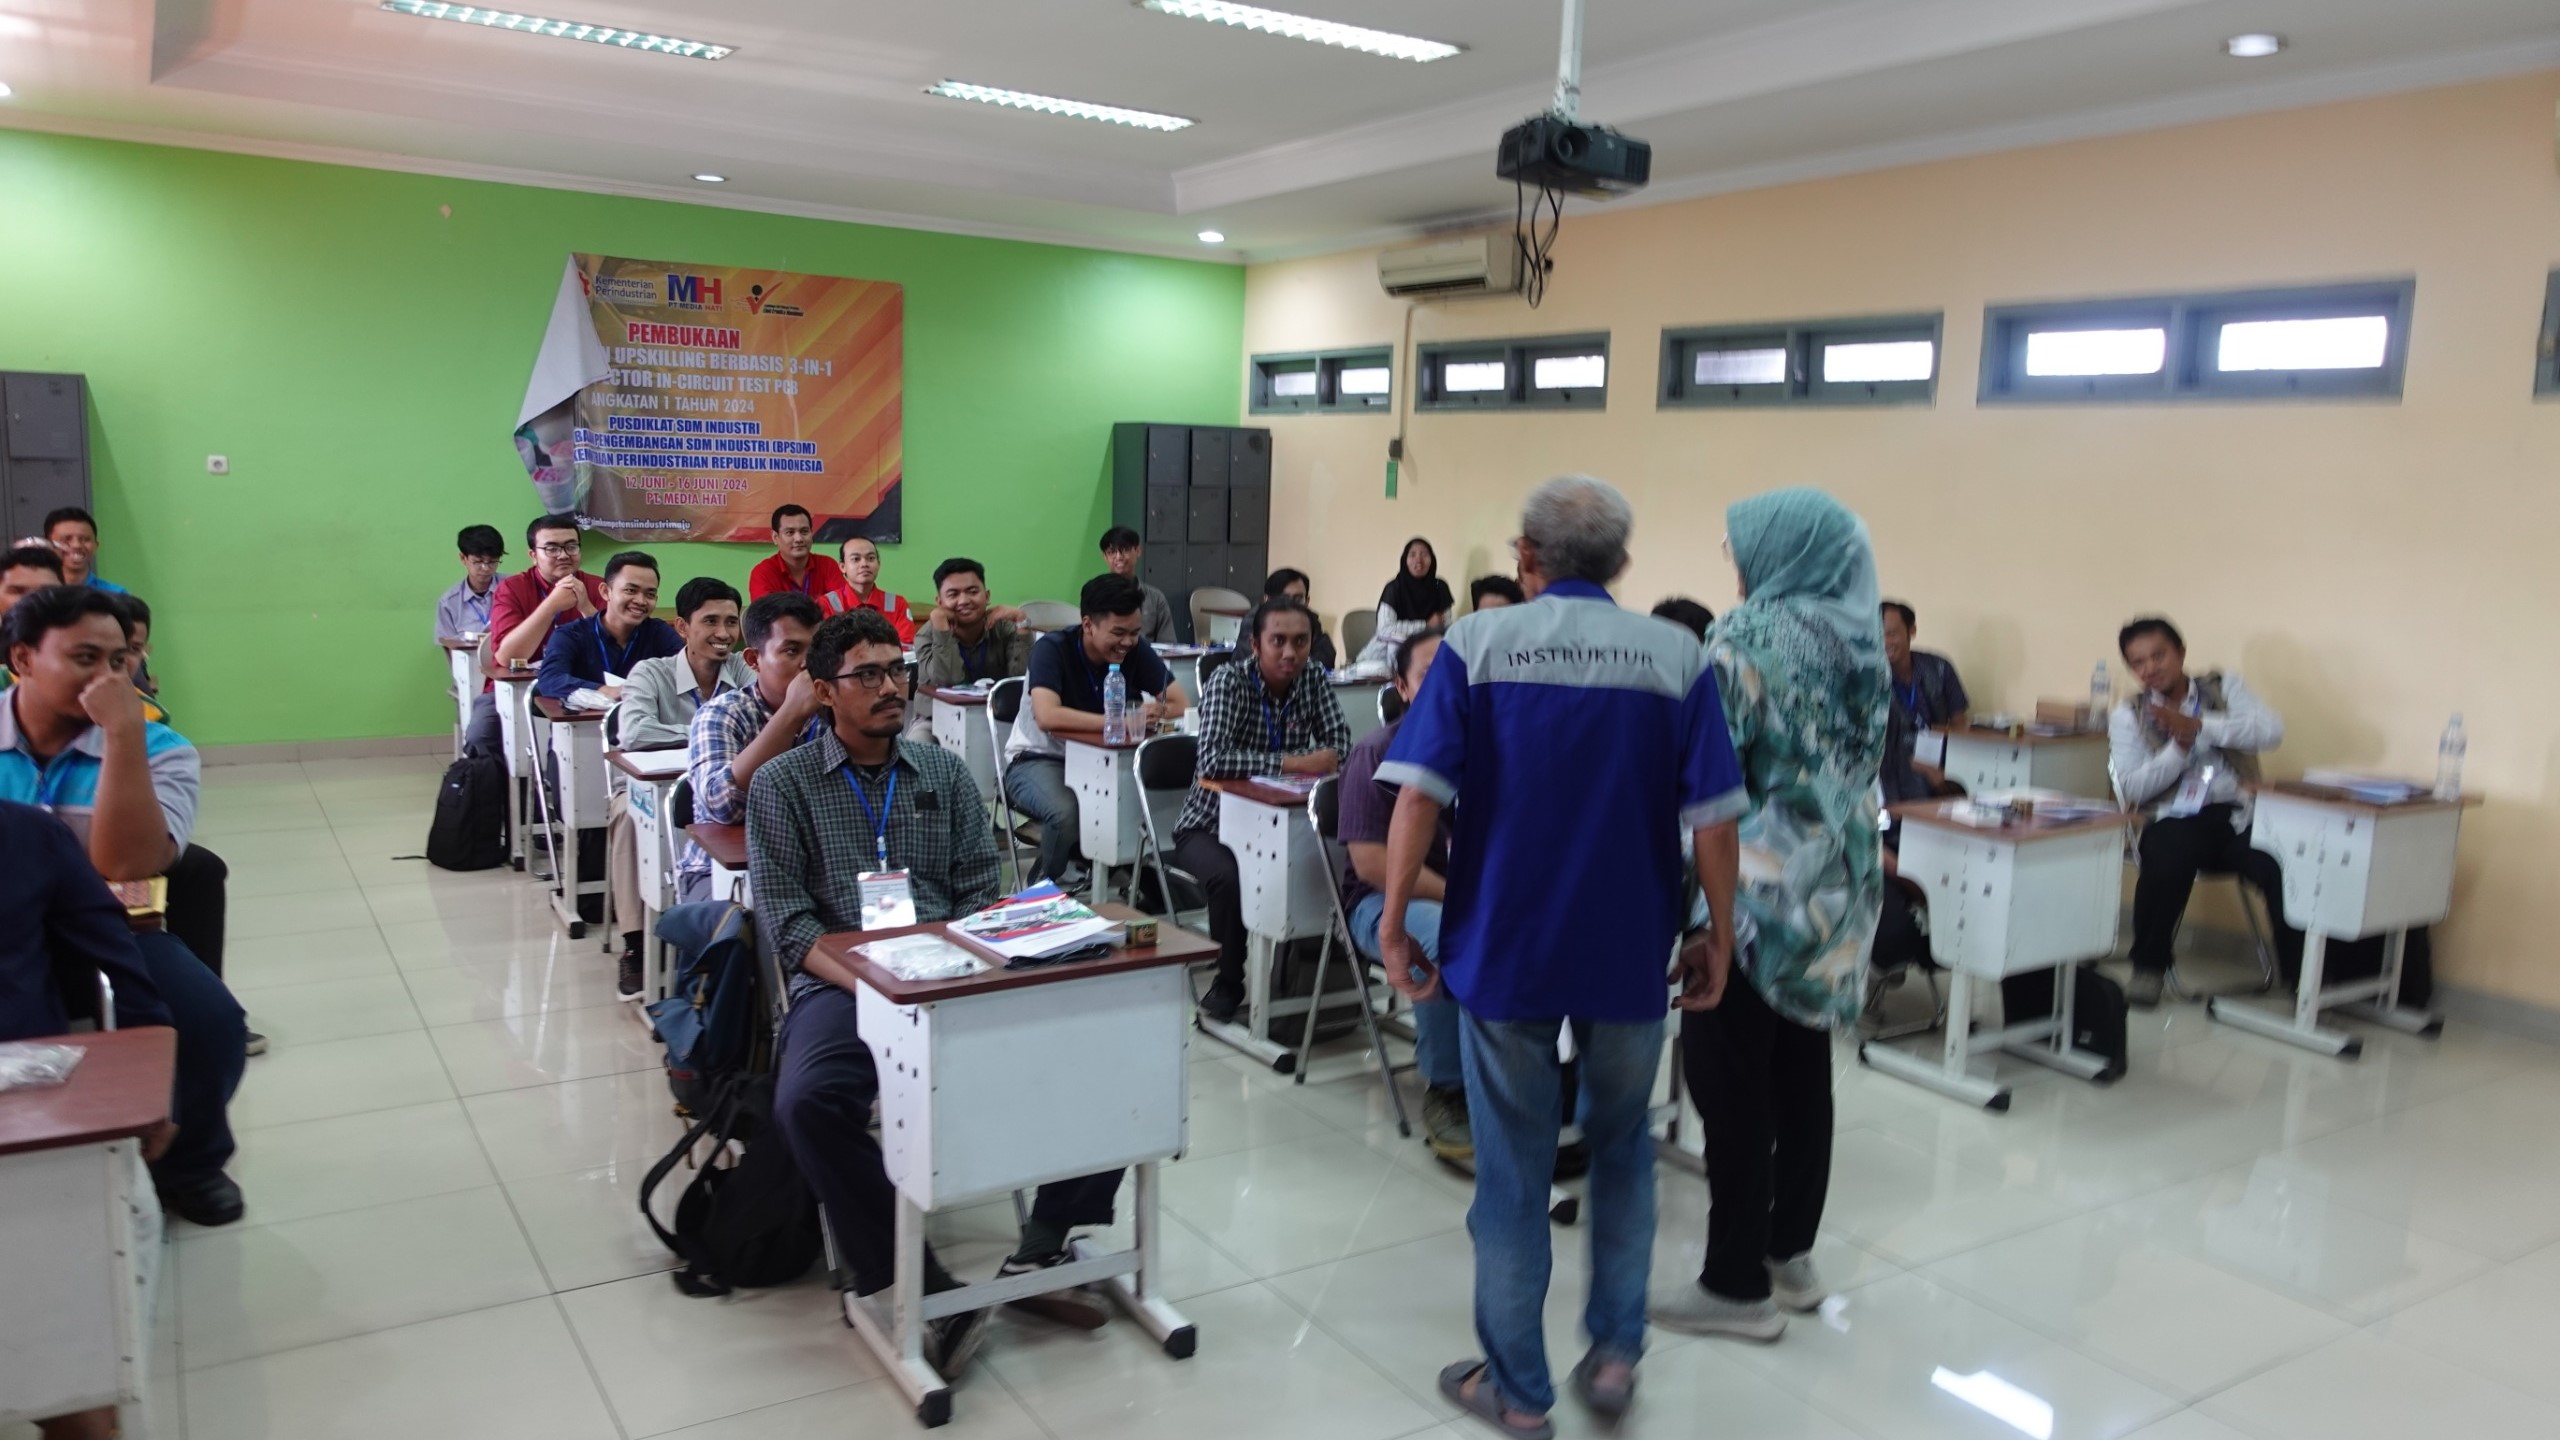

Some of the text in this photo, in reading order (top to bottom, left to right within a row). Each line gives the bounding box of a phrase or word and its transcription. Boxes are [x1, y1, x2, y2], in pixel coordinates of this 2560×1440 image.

[595, 275, 654, 289] Kementerian
[668, 275, 722, 304] MH
[595, 285, 657, 299] Perindustrian
[628, 322, 740, 349] PEMBUKAAN
[615, 347, 705, 369] UPSKILLING
[710, 353, 784, 373] BERBASIS
[790, 358, 832, 376] 3-IN-1
[604, 368, 798, 395] CTOR IN-CIRCUIT TEST PCB
[664, 396, 669, 410] 1
[675, 396, 719, 412] TAHUN
[723, 399, 755, 413] 2024
[609, 416, 760, 435] PUSDIKLAT SDM INDUSTRI
[594, 433, 683, 450] PENGEMBANGAN
[686, 437, 712, 451] SDM
[715, 438, 770, 453] INDUSTRI
[772, 441, 816, 455] (BPSDM)
[616, 453, 708, 469] PERINDUSTRIAN
[711, 456, 767, 470] REPUBLIK
[769, 458, 823, 472] INDONESIA
[625, 476, 637, 488] 12
[640, 476, 666, 489] JUNI
[678, 477, 690, 490] 16
[694, 477, 719, 490] JUNI
[723, 478, 747, 490] 2024
[664, 493, 699, 505] MEDIA
[702, 494, 727, 505] HATI
[1507, 648, 1654, 669] INSTRUKTUR
